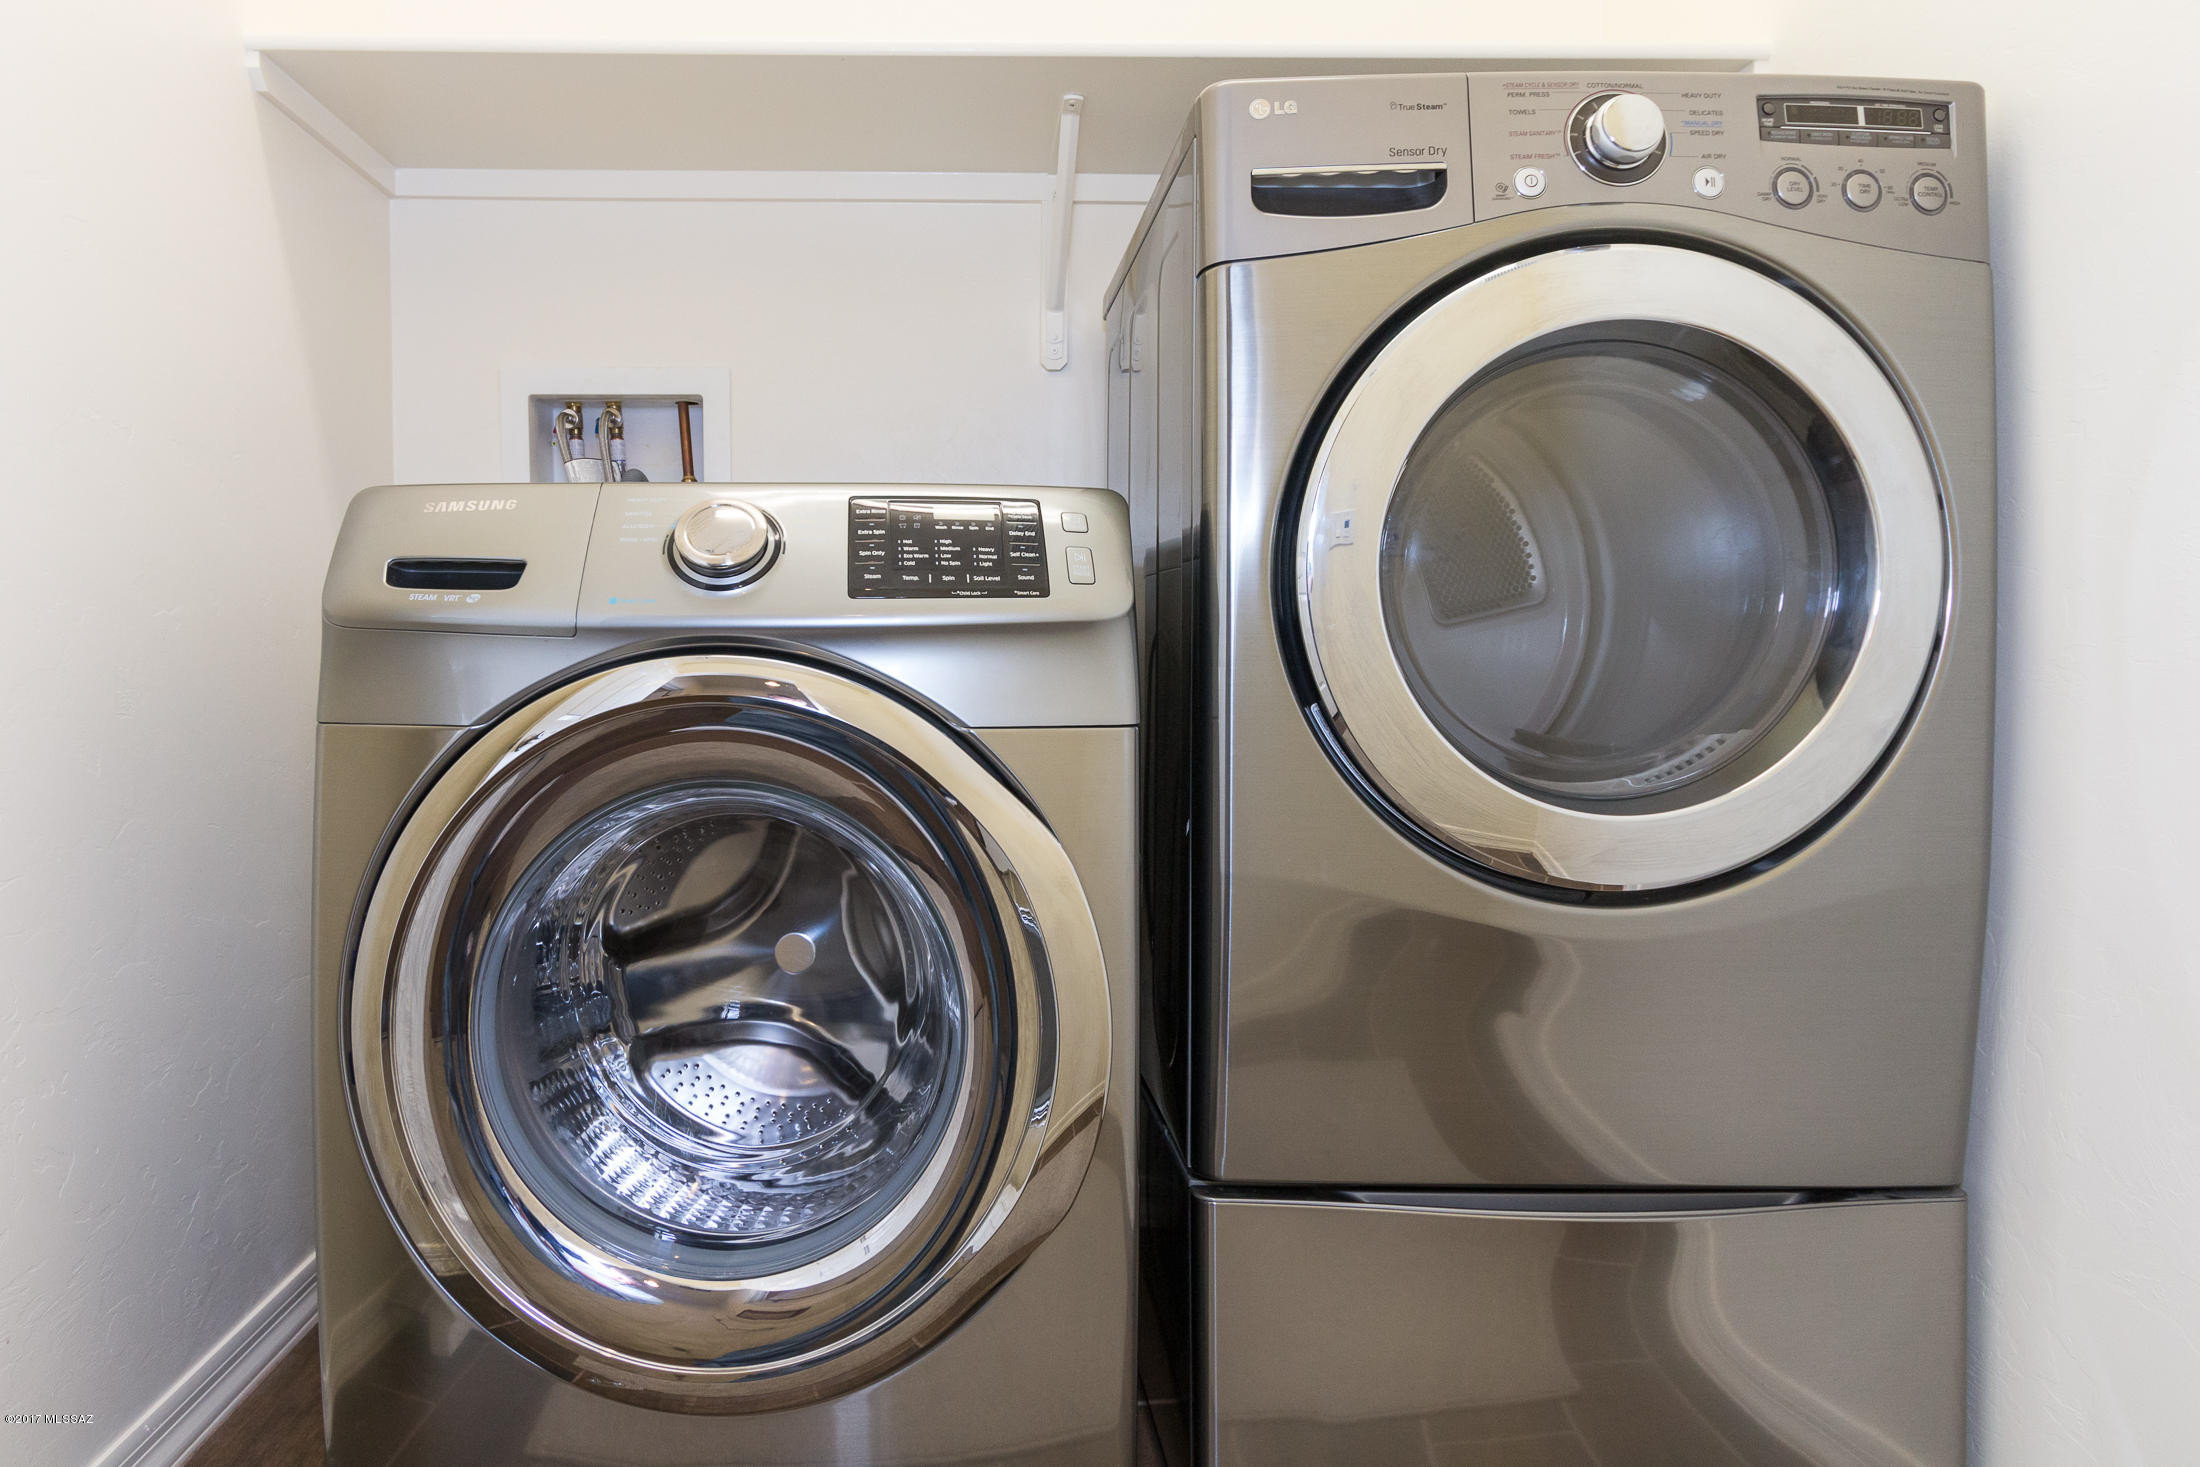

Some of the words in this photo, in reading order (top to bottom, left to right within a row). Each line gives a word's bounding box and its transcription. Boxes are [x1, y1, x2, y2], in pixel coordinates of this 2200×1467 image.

[1273, 100, 1297, 115] LG
[1388, 147, 1426, 158] Sensor
[1428, 146, 1448, 159] Dry
[423, 498, 518, 513] SAMSUNG
[408, 593, 438, 601] STEAM
